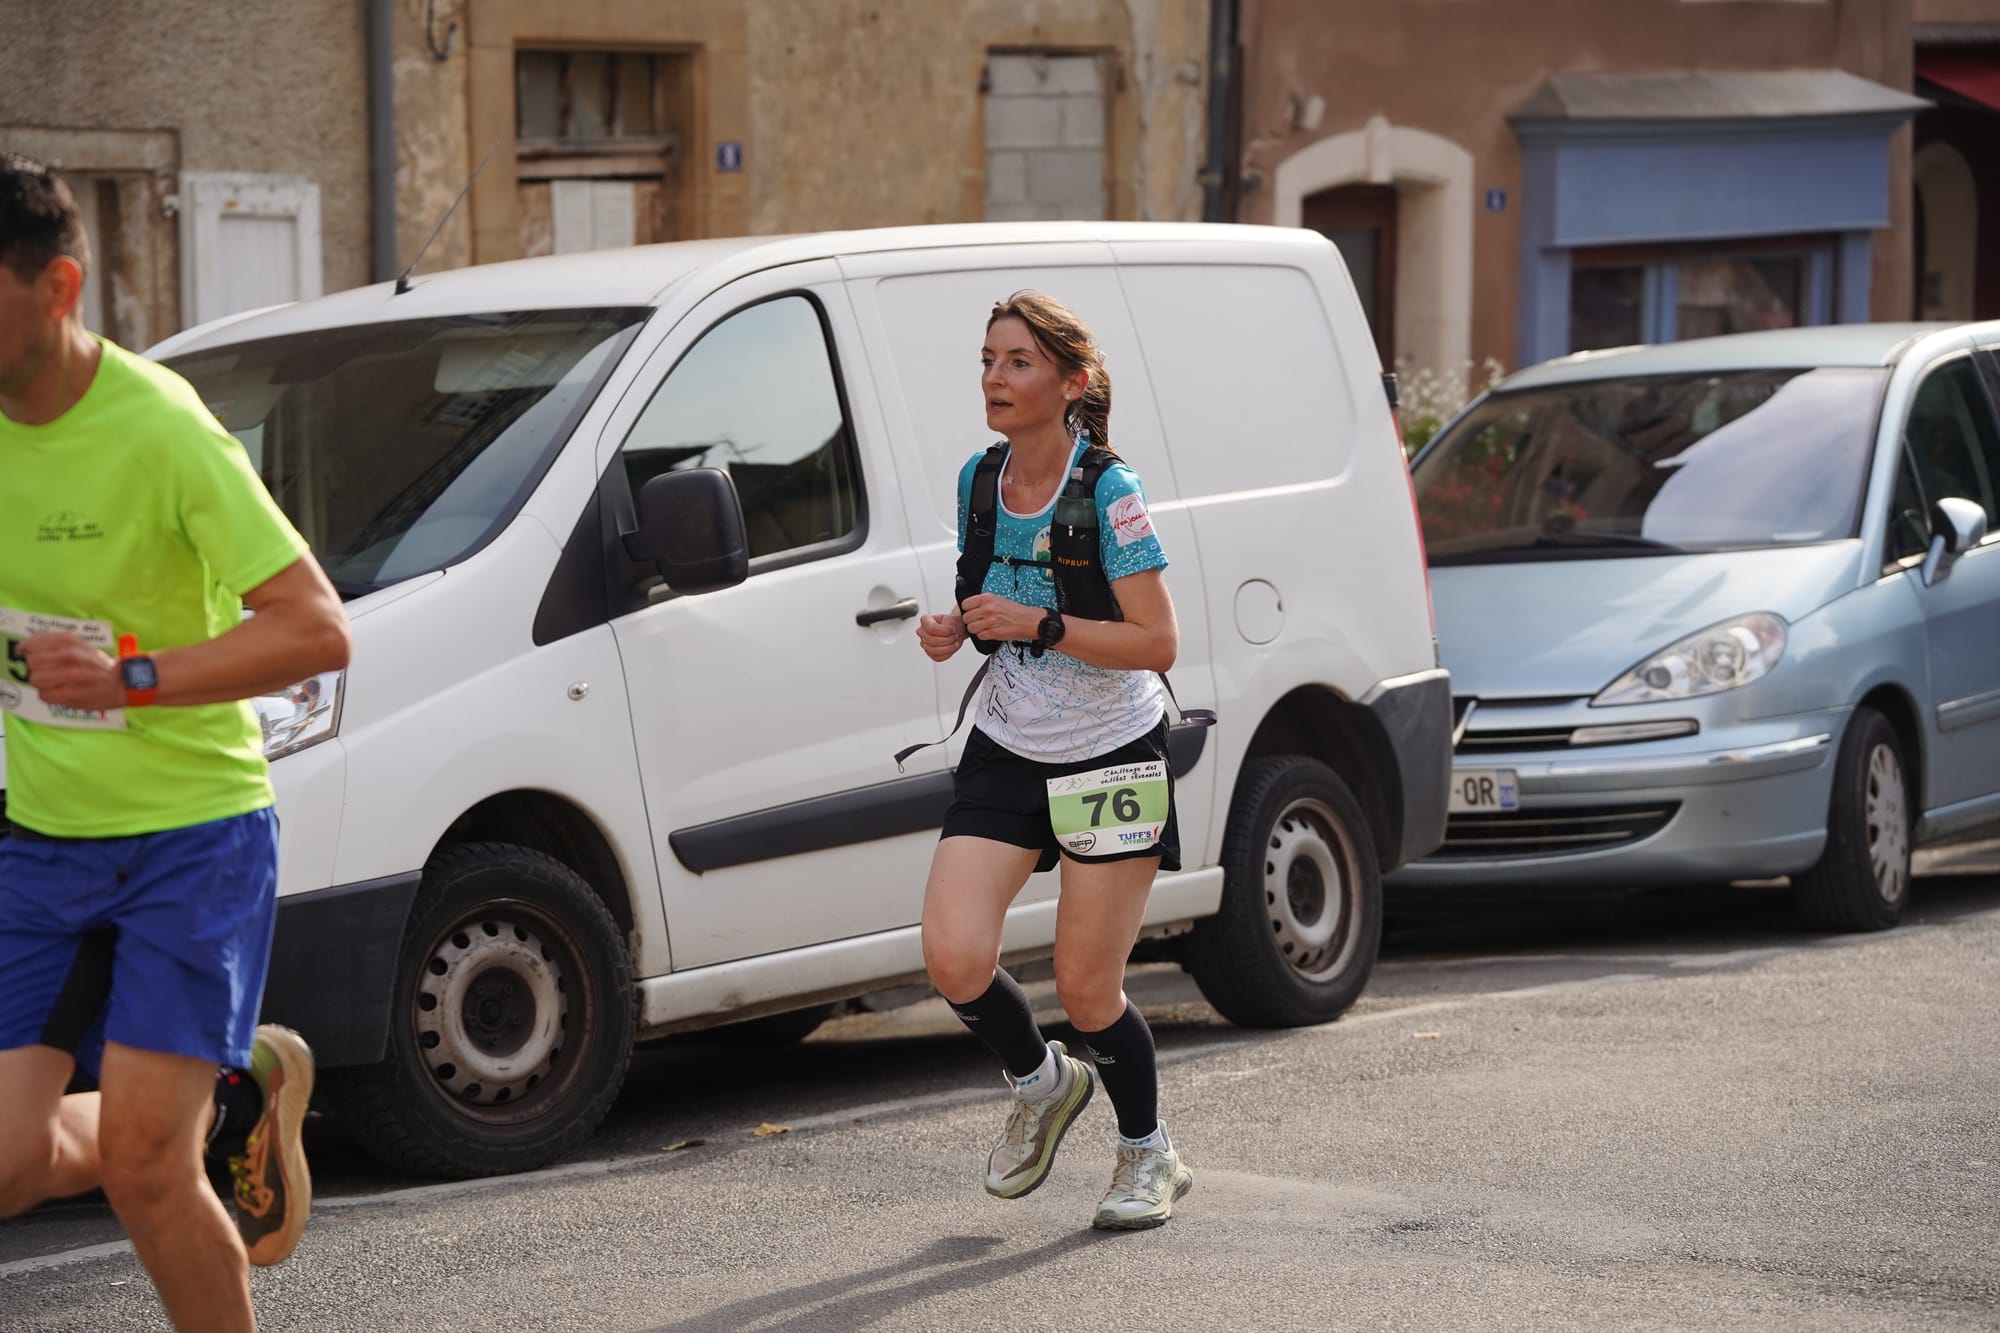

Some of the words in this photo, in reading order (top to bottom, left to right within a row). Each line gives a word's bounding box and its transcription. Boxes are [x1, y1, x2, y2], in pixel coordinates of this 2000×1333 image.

[1057, 555, 1089, 567] KIPRUN
[1103, 767, 1141, 776] Challenge
[1081, 788, 1141, 828] 76
[1117, 831, 1152, 841] TUFF'S
